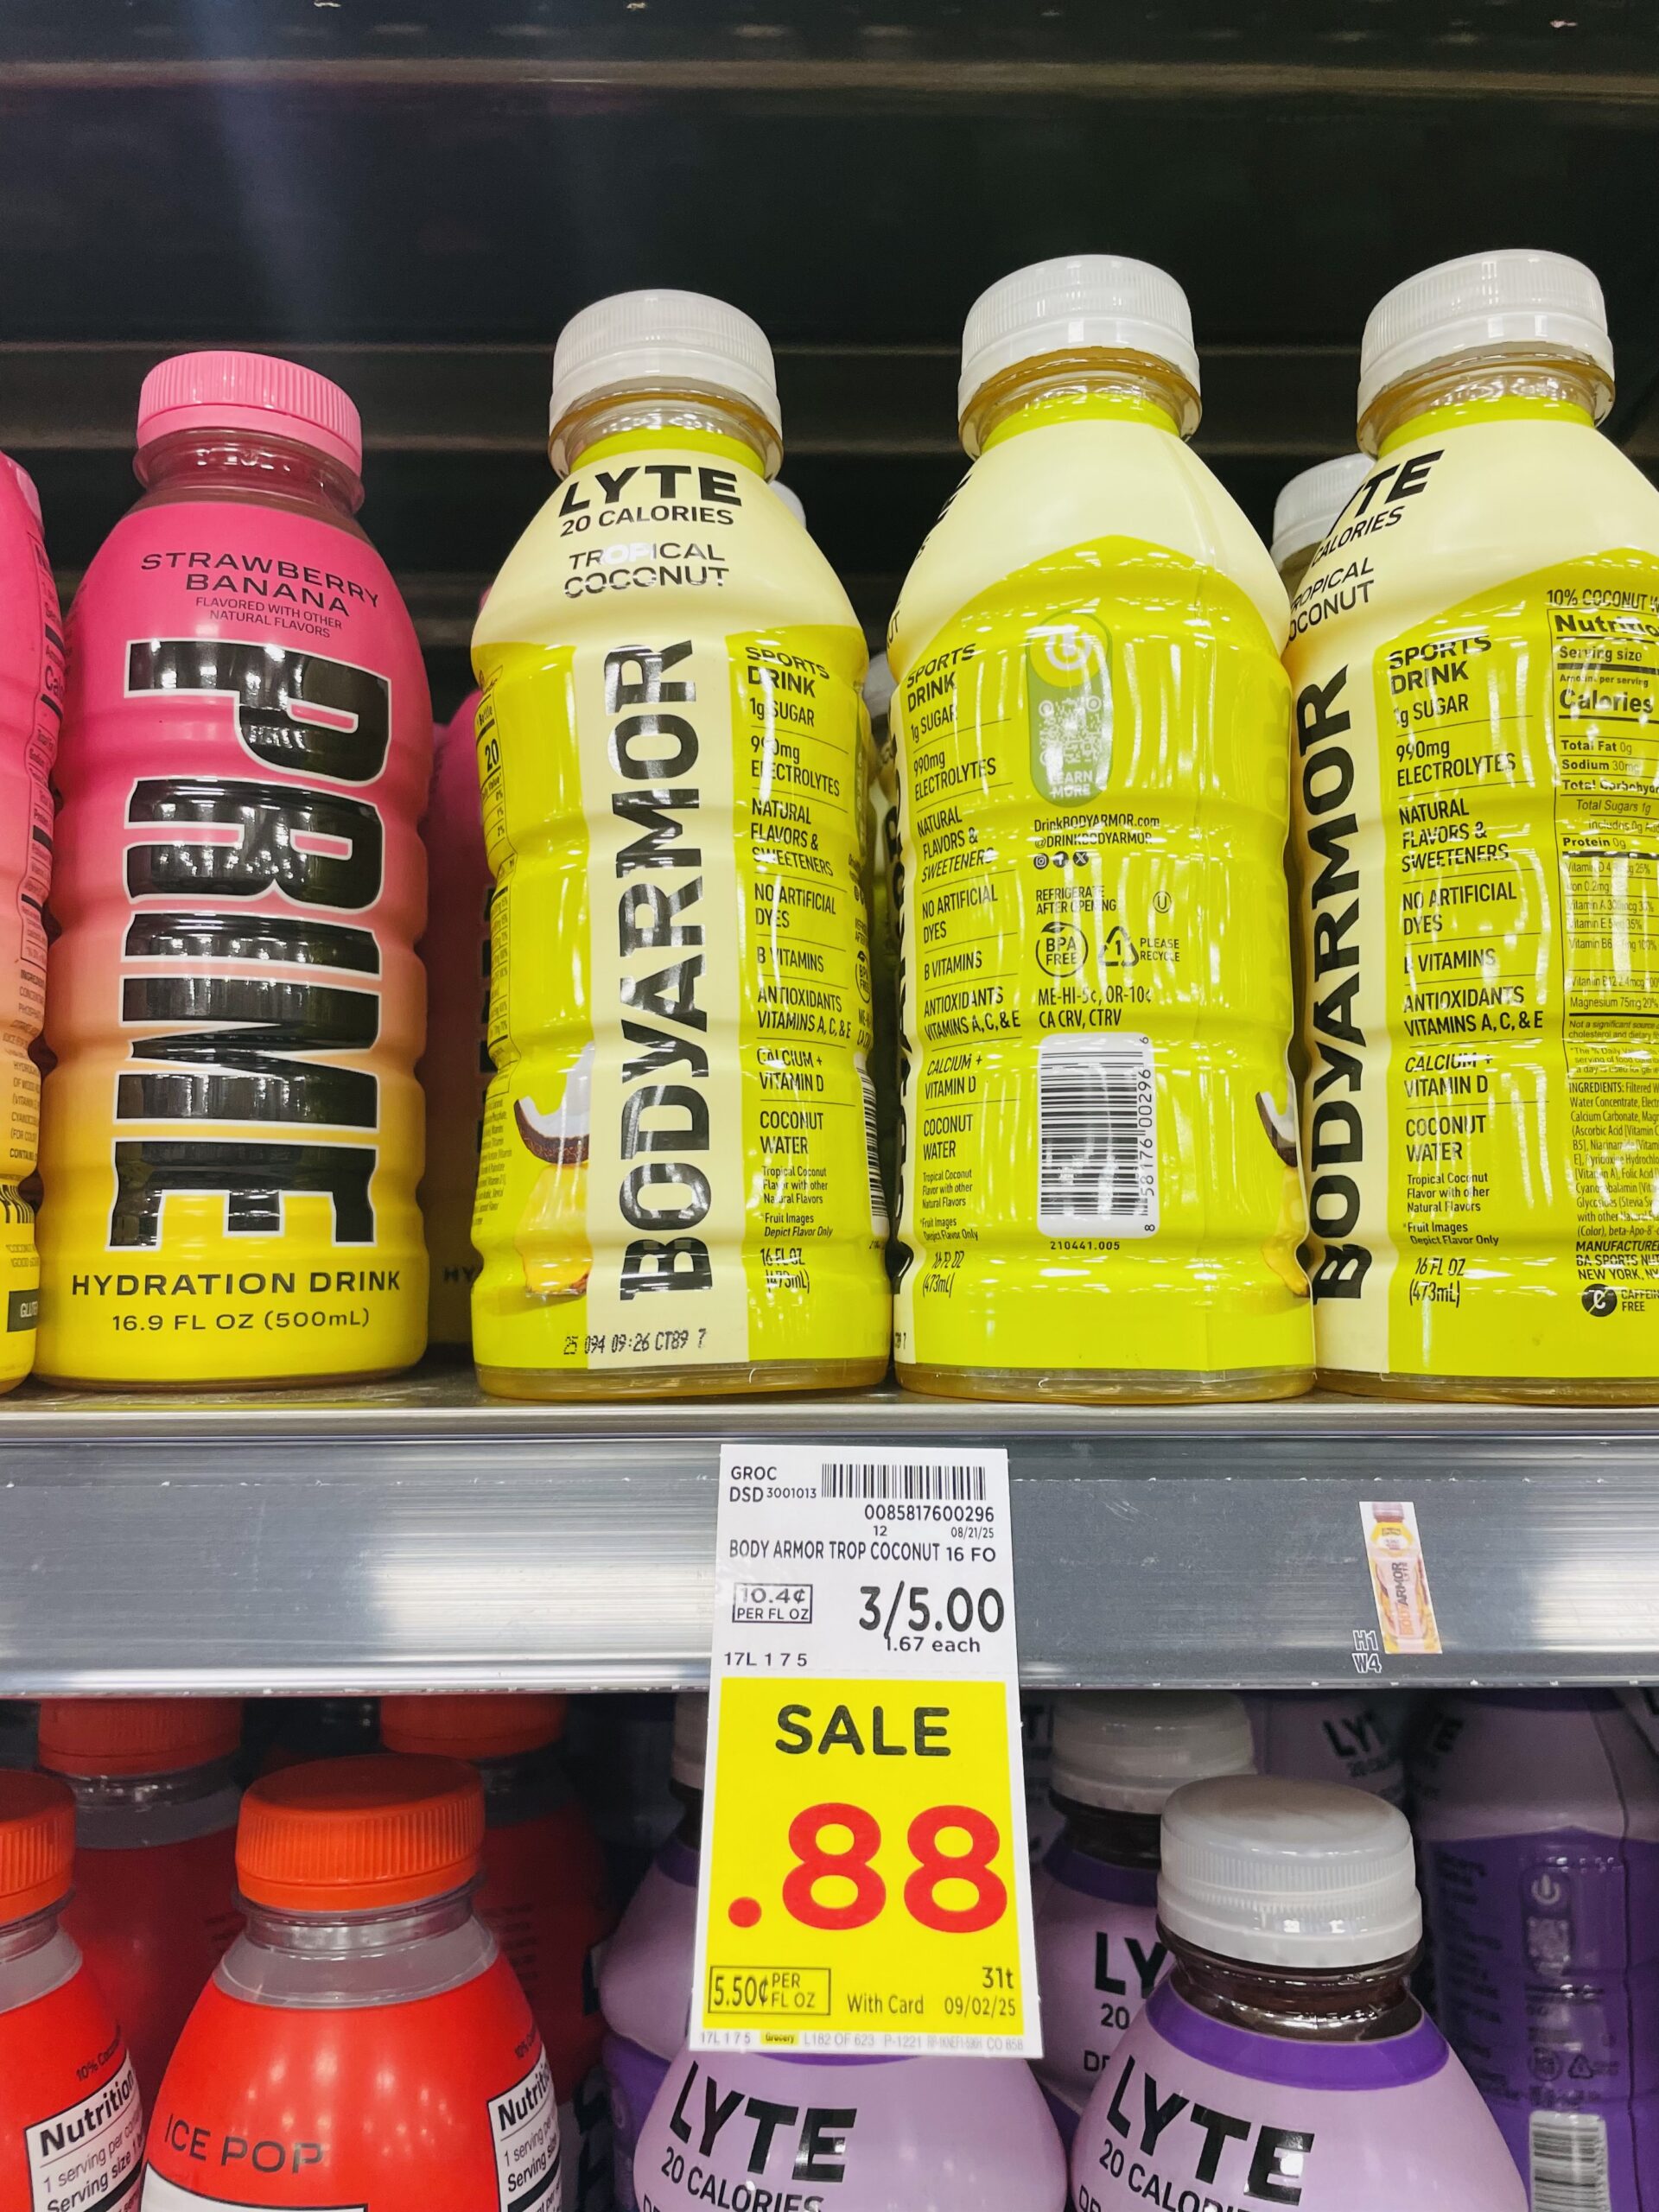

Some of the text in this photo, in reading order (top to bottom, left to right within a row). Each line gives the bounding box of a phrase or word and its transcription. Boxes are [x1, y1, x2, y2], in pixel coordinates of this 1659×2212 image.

[558, 465, 742, 517] LYTE
[560, 505, 734, 537] 20 CALORIES
[569, 542, 725, 570] TROPICAL
[141, 552, 378, 607] STRAWBERRY
[564, 565, 729, 599] COCONUT
[186, 574, 349, 617] BANANA
[1547, 589, 1648, 612] 10% COCONUT
[196, 597, 342, 630] FLAVORED WITH OTHER
[1289, 580, 1374, 641] OCONUT
[210, 610, 330, 638] NATURAL FLAVORS
[745, 646, 830, 680] SPORTS
[906, 643, 976, 689] SPORTS
[1560, 646, 1642, 663] Serving size
[748, 665, 816, 698] DRINK
[1391, 660, 1468, 695] DRINK
[907, 671, 955, 713] DRINK
[1560, 689, 1653, 714] Calories
[1396, 741, 1450, 762] 990mg
[1561, 741, 1632, 755] Total Fat 0g
[913, 751, 945, 778] 990mg
[1398, 753, 1516, 787] ELECTROLYTES
[915, 757, 996, 802] ELECTROLYTES
[752, 798, 811, 825] NATURAL
[1399, 798, 1469, 825] NATURAL
[1577, 799, 1601, 810] Total
[1605, 800, 1638, 813] Sugars
[917, 805, 963, 838] NATURAL
[1034, 813, 1160, 832] DrinkBODYARMOR.com
[751, 823, 819, 851] FLAVORS &
[923, 827, 978, 861] FLAVORS &
[1563, 837, 1626, 849] Protein 0g
[1402, 881, 1516, 911] NO ARTIFICIAL
[924, 920, 947, 944] DYES
[1046, 937, 1077, 951] BPA
[1141, 938, 1179, 949] PLEASE
[105, 638, 391, 1252] PRIME
[1141, 951, 1180, 962] RECYCLE
[604, 639, 713, 1300] BODYARMOR
[1046, 953, 1077, 965] FREE
[1297, 664, 1372, 1304] BODYARMOR
[758, 985, 842, 1013] ANTIOXIDANTS
[1039, 1008, 1122, 1029] CA CRV, CTRV
[760, 1110, 823, 1130] COCONUT
[923, 1114, 973, 1137] COCONUT
[1406, 1115, 1486, 1136] COCONUT
[760, 1135, 808, 1154] WATER
[1138, 1036, 1155, 1232] 8 58176 00296 6
[923, 1140, 957, 1161] WATER
[1407, 1142, 1462, 1161] WATER
[765, 1226, 833, 1238] Depict Flavor Only
[1051, 1241, 1120, 1250] 210441.005
[72, 1271, 400, 1295] HYDRATION DRINK
[1578, 1268, 1644, 1281] NEW YORK,
[1622, 1301, 1645, 1312] FREE
[112, 1308, 369, 1331] 16.9 FL OZ (500mL)
[611, 1332, 650, 1353] 09:26
[655, 1330, 689, 1351] CT89
[731, 1466, 777, 1481] GROC
[729, 1486, 817, 1503] DSD 3001013
[864, 1504, 995, 1522] 0085817600296
[873, 1525, 995, 1540] 12 08/21/25
[729, 1540, 996, 1562] BODY ARMOR TROP COCONUT 16 FO
[741, 1587, 806, 1605] 10.4¢
[737, 1608, 809, 1621] PER FL OZ
[859, 1580, 1004, 1639] 3/5.00
[886, 1637, 981, 1653] 1.67 each
[1353, 1630, 1379, 1650] H1
[724, 1652, 808, 1667] 17L 1 7 5
[1351, 1653, 1382, 1673] W4
[775, 1704, 950, 1756] SALE
[728, 1802, 1007, 1933] .88
[715, 1972, 800, 2006] 5.50¢ PER
[982, 1967, 1014, 1989] 31t
[772, 1992, 816, 2008] FL OZ
[848, 1994, 1016, 2018] With Card 09/02/25
[1101, 2003, 1129, 2030] 20
[765, 2033, 795, 2044] Grocery
[804, 2033, 875, 2047] L182 OF 623
[884, 2035, 921, 2048] P-1221
[40, 2069, 134, 2157] Nutrition
[670, 2060, 857, 2183] LYTE
[1107, 2055, 1315, 2205] LYTE
[165, 2113, 324, 2175] ICE POP
[43, 2136, 123, 2193] 1 serving per
[661, 2146, 684, 2183] 20
[1099, 2139, 1123, 2178] 20
[47, 2151, 131, 2212] Serving size
